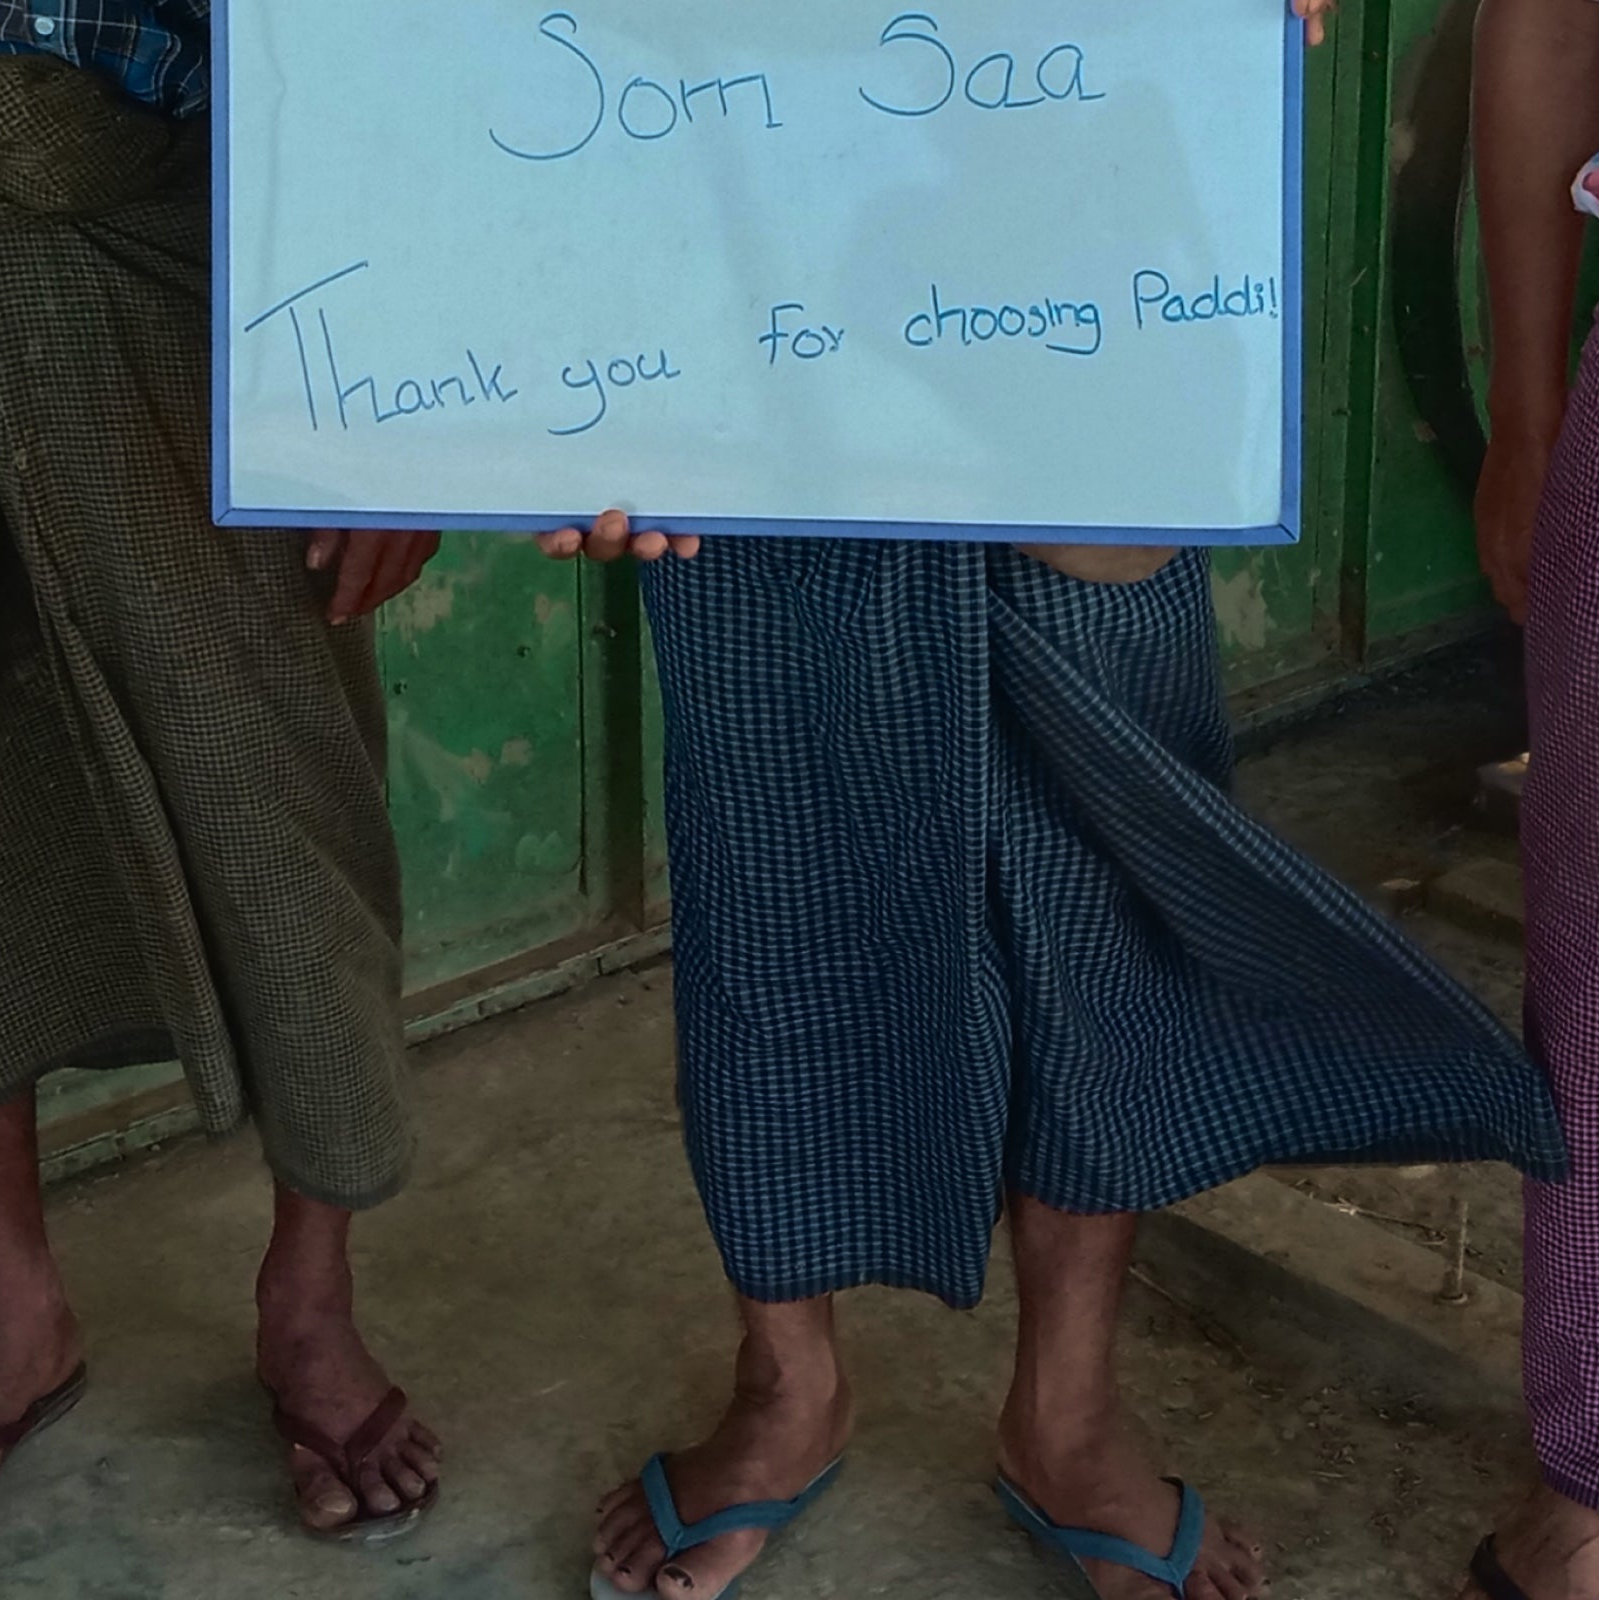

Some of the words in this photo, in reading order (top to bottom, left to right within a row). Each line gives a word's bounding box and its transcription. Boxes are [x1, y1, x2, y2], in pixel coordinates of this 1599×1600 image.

[489, 13, 783, 160] Som
[859, 14, 1106, 116] Saa
[245, 260, 518, 430] Thank
[547, 349, 681, 435] you
[905, 290, 1101, 355] choosing
[1133, 270, 1276, 330] Paddi!
